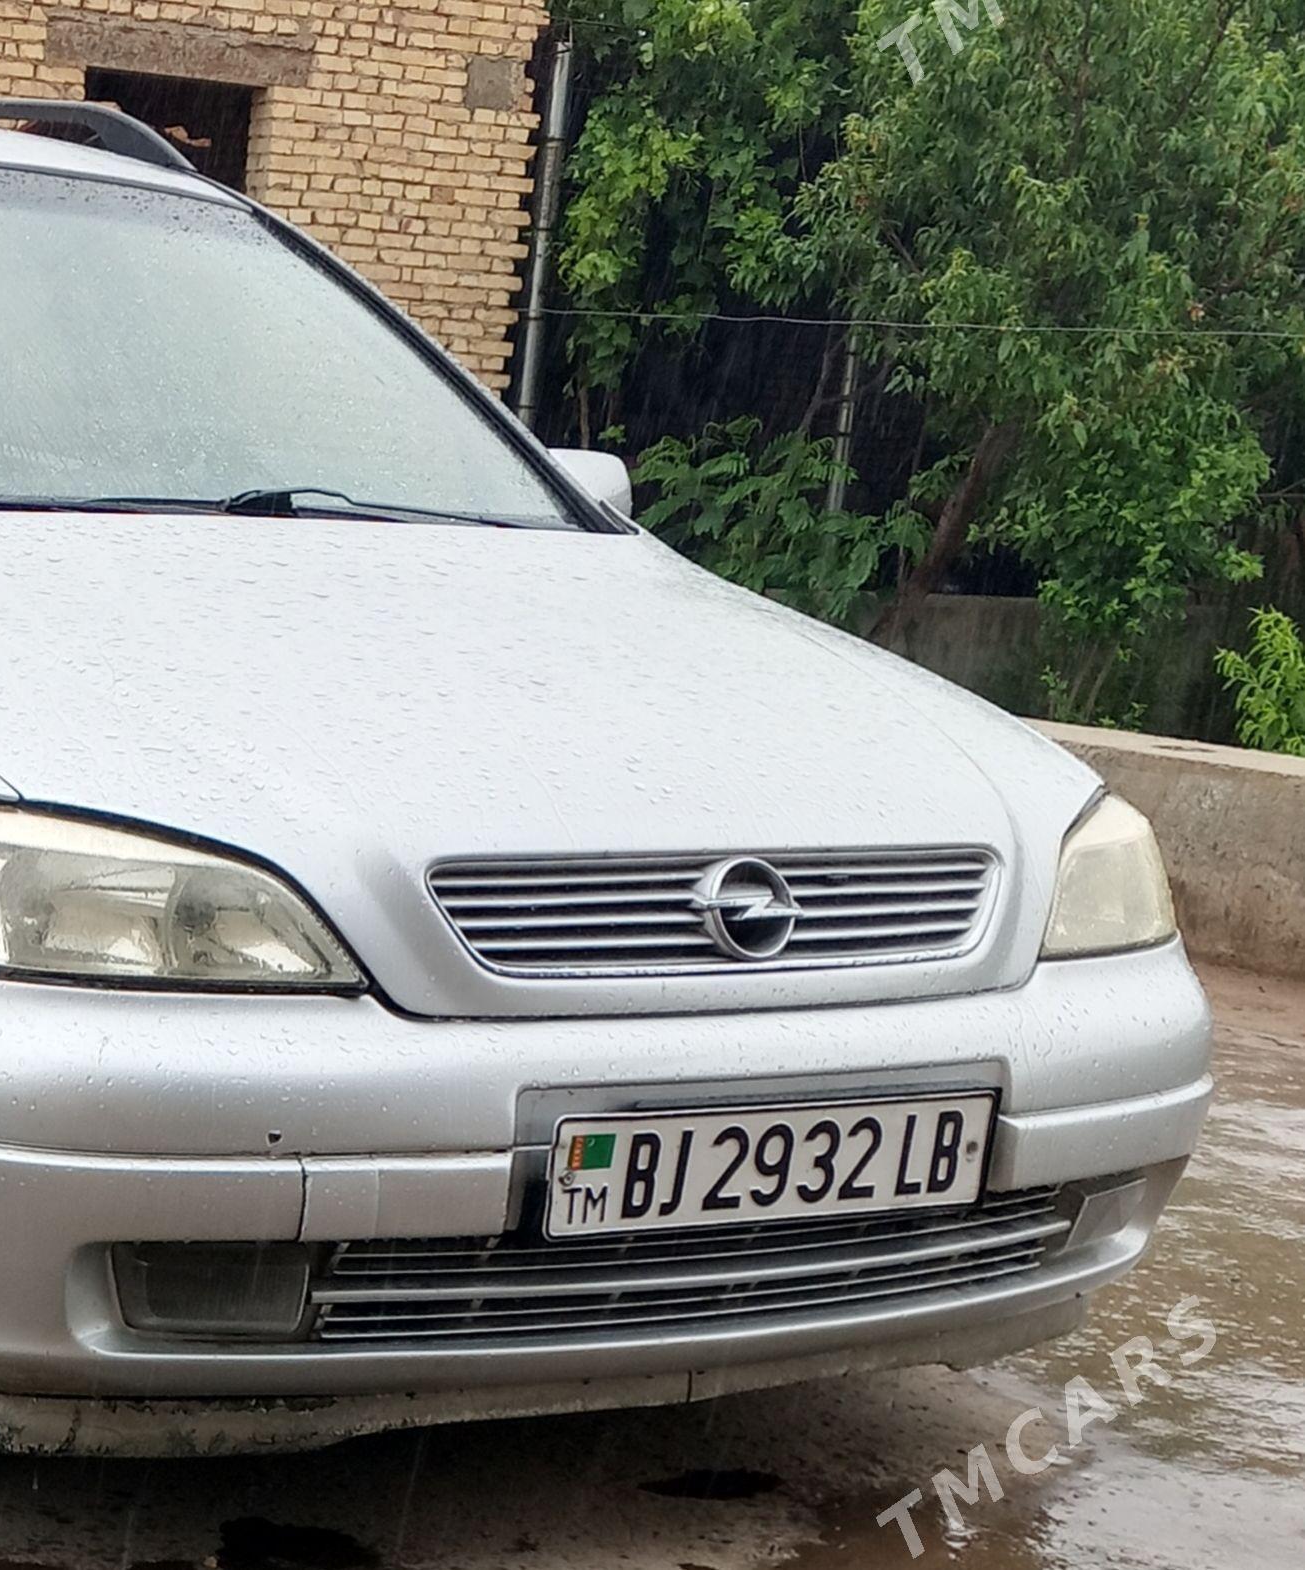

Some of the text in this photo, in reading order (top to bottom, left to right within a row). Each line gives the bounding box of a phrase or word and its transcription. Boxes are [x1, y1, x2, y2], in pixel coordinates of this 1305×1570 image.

[621, 1110, 964, 1218] BJ 2932 LB
[562, 1185, 608, 1225] TM
